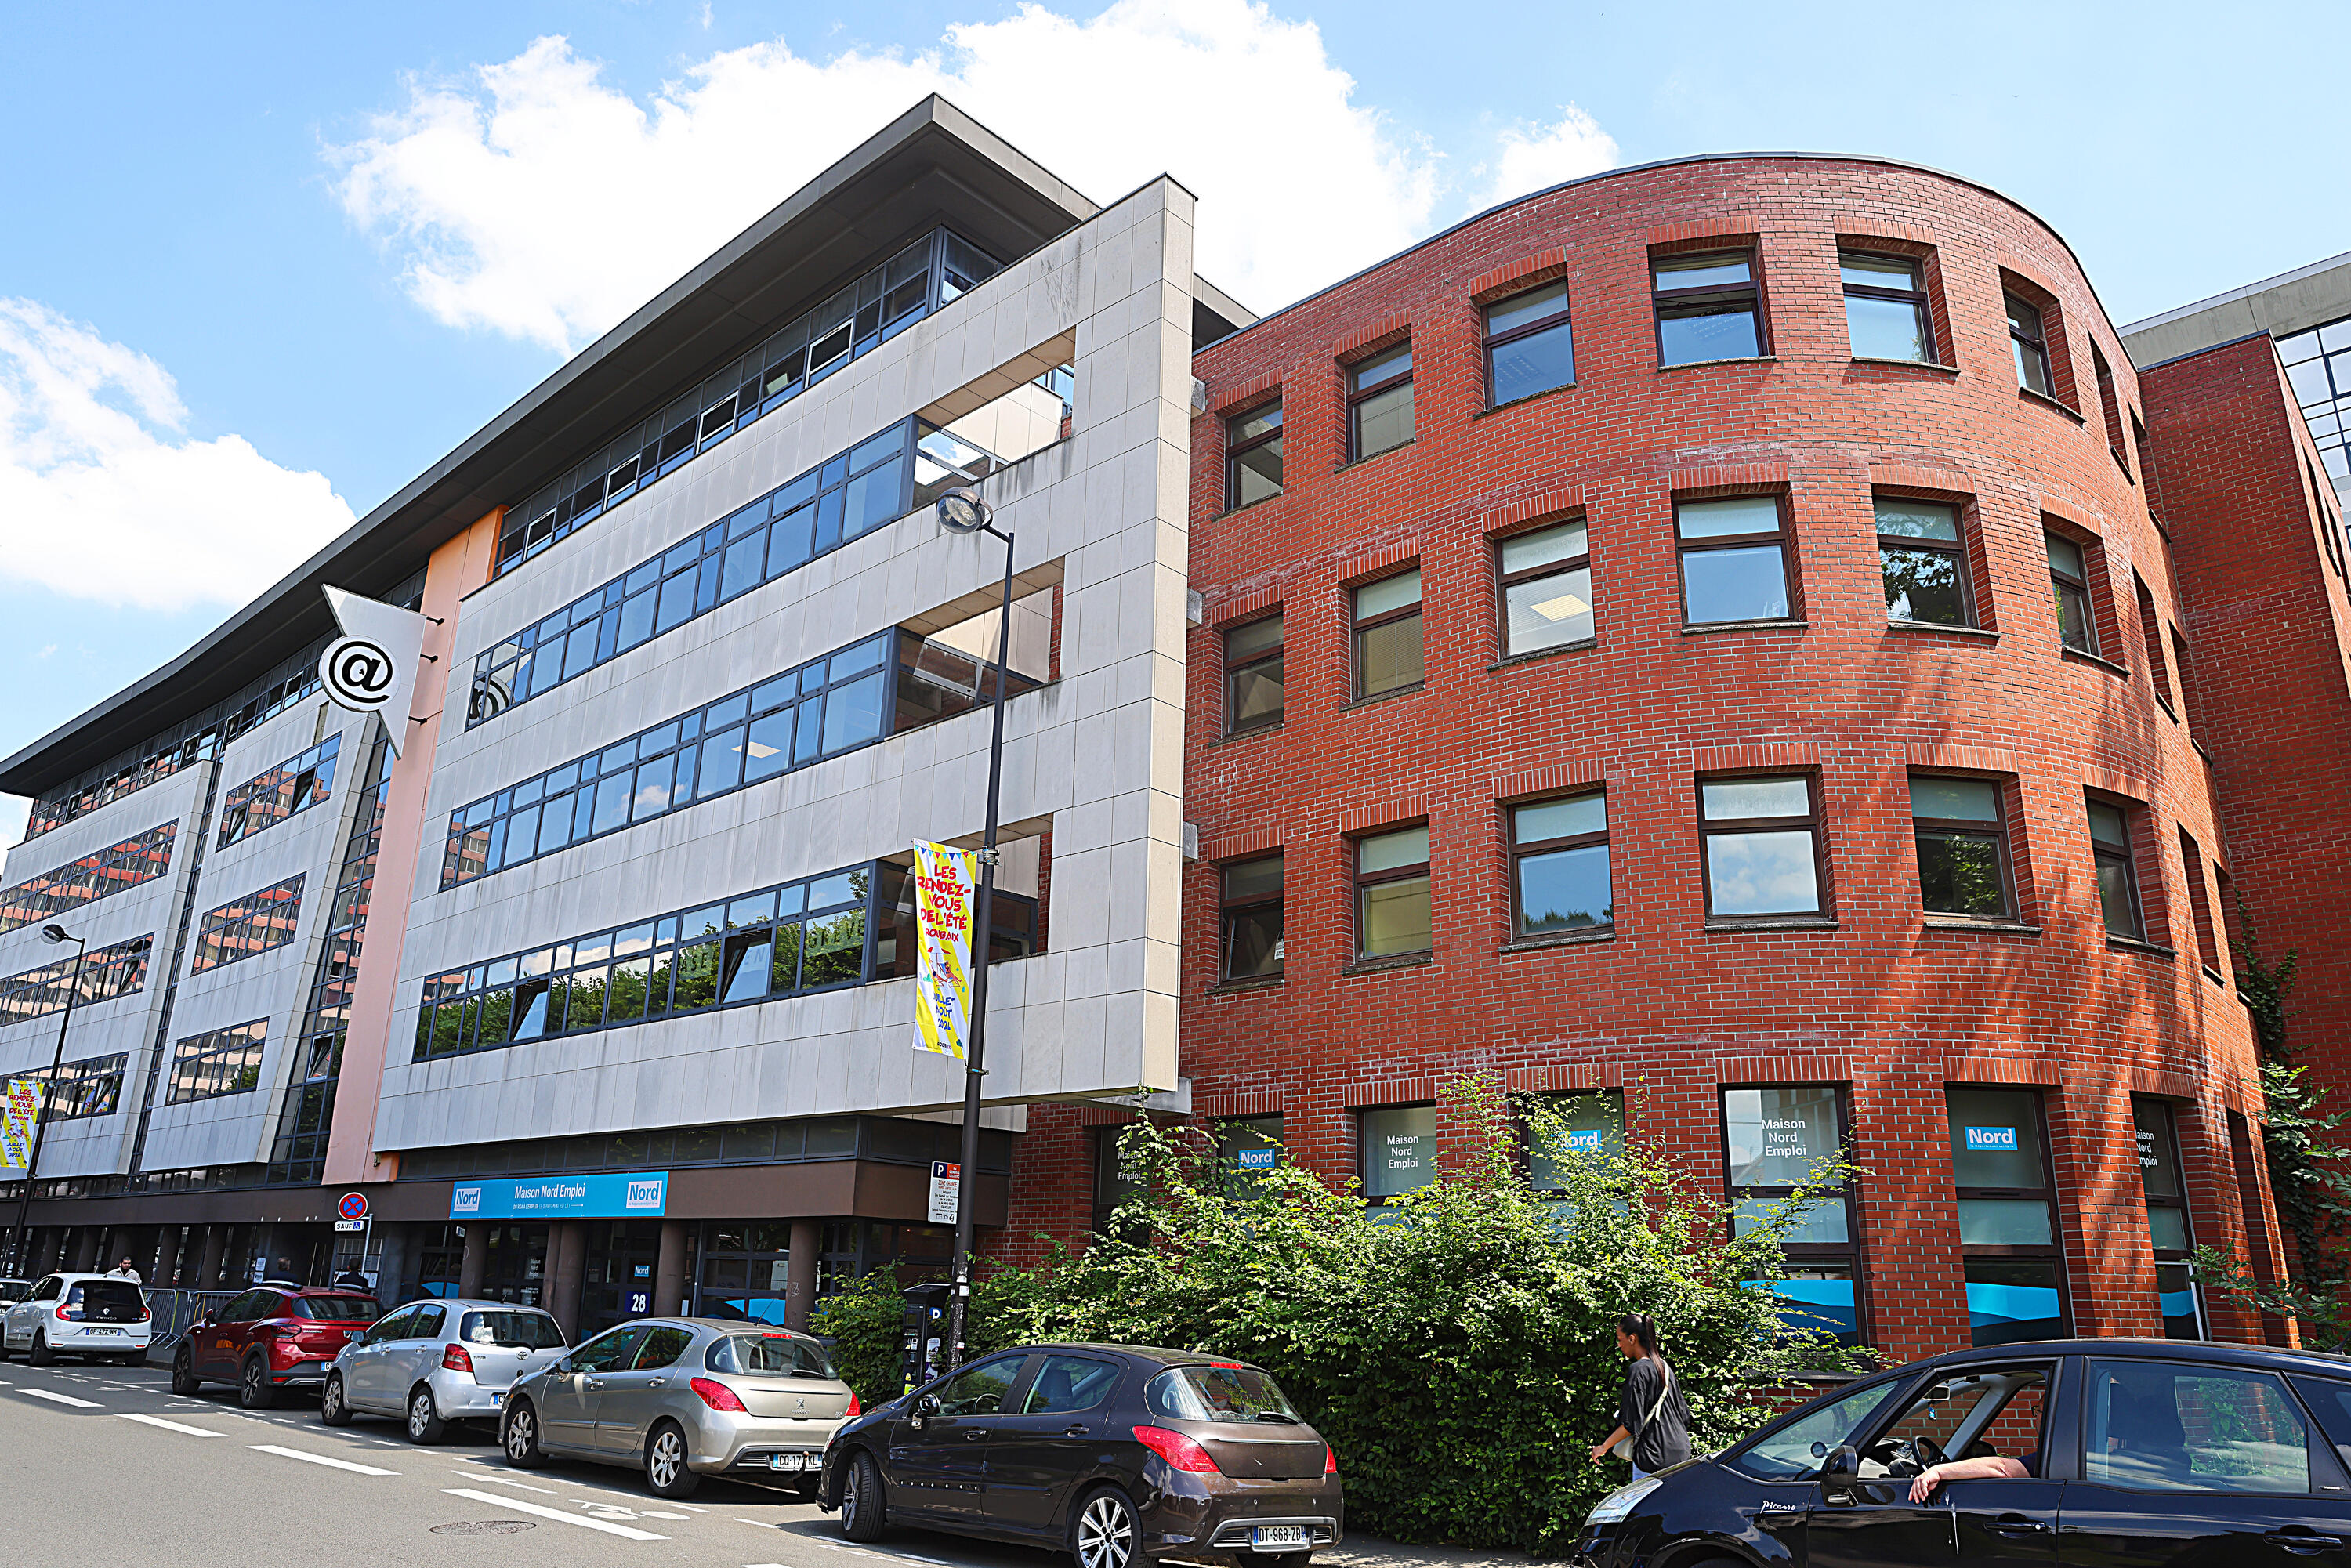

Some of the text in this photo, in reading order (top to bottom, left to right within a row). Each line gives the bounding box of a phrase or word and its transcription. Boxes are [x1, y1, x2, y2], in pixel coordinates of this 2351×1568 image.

[329, 641, 393, 704] @
[934, 864, 957, 880] LES
[917, 876, 971, 897] RENDEZ-
[928, 894, 962, 912] VOUS
[926, 928, 959, 942] ROUBAIX
[1761, 1117, 1806, 1130] Maison
[1387, 1134, 1418, 1145] Maison
[1559, 1131, 1598, 1147] ord
[1768, 1131, 1798, 1143] Nord
[1969, 1128, 2013, 1144] Nord
[2135, 1128, 2154, 1140] aison
[1241, 1150, 1273, 1164] Nord
[1391, 1146, 1412, 1157] Nord
[1765, 1144, 1806, 1158] Emploi
[1388, 1157, 1418, 1170] Emploi
[2139, 1155, 2157, 1168] mploi
[937, 1164, 944, 1176] P
[1118, 1171, 1141, 1182] Emploi
[456, 1189, 479, 1204] Nord
[514, 1182, 586, 1200] Maison Nord Emploi
[629, 1182, 659, 1200] Nord
[635, 1266, 649, 1274] Nord
[631, 1294, 647, 1313] 28
[1760, 1500, 1795, 1514] Picasso
[1259, 1526, 1301, 1542] DT-968-ZB
